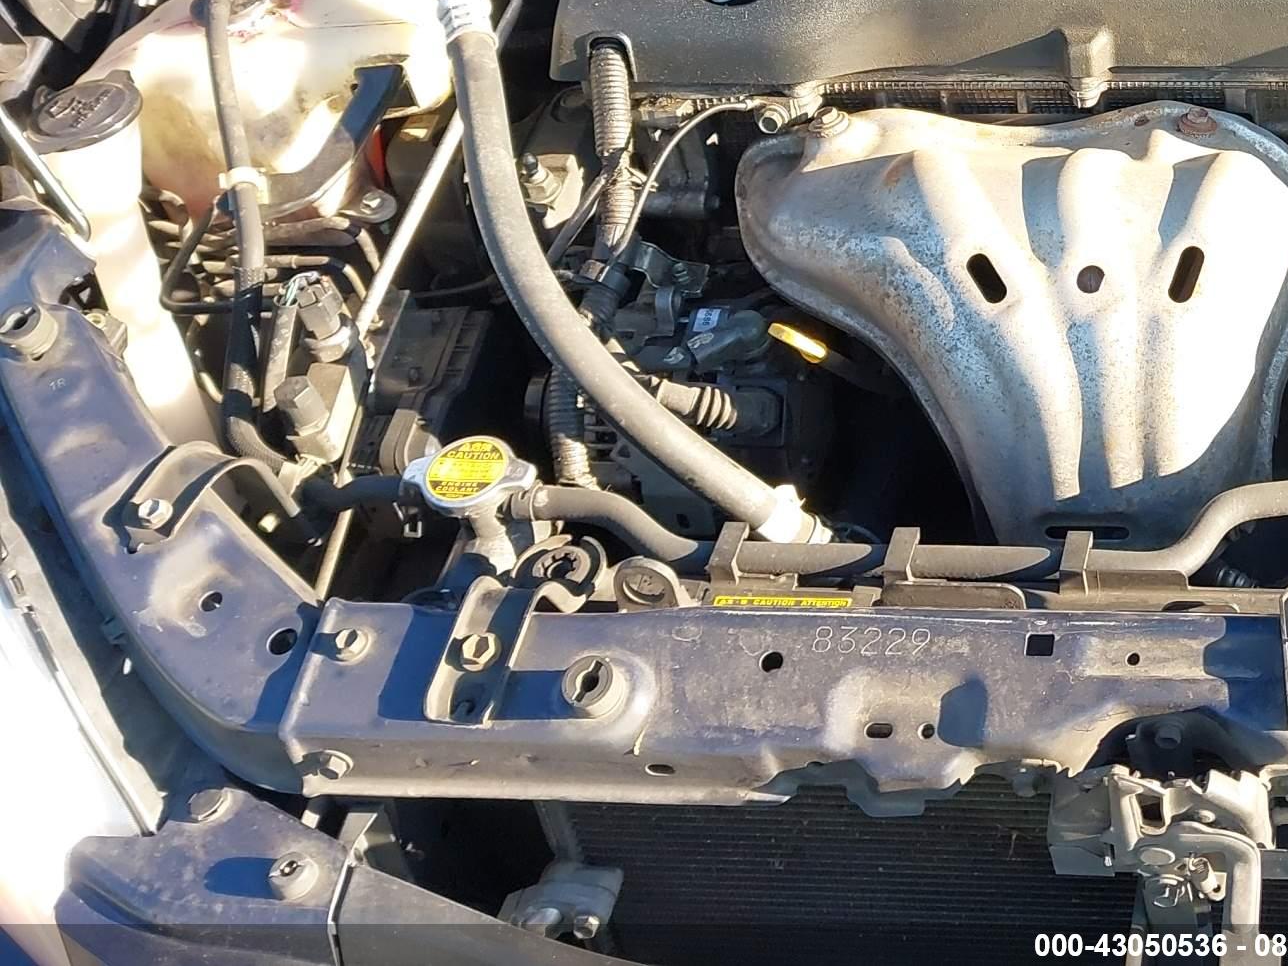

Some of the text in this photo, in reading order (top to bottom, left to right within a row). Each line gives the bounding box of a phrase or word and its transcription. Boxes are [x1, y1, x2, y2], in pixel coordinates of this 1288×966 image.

[447, 450, 500, 460] CAUTION
[800, 599, 848, 607] ATTENTION
[812, 626, 931, 656] 83229
